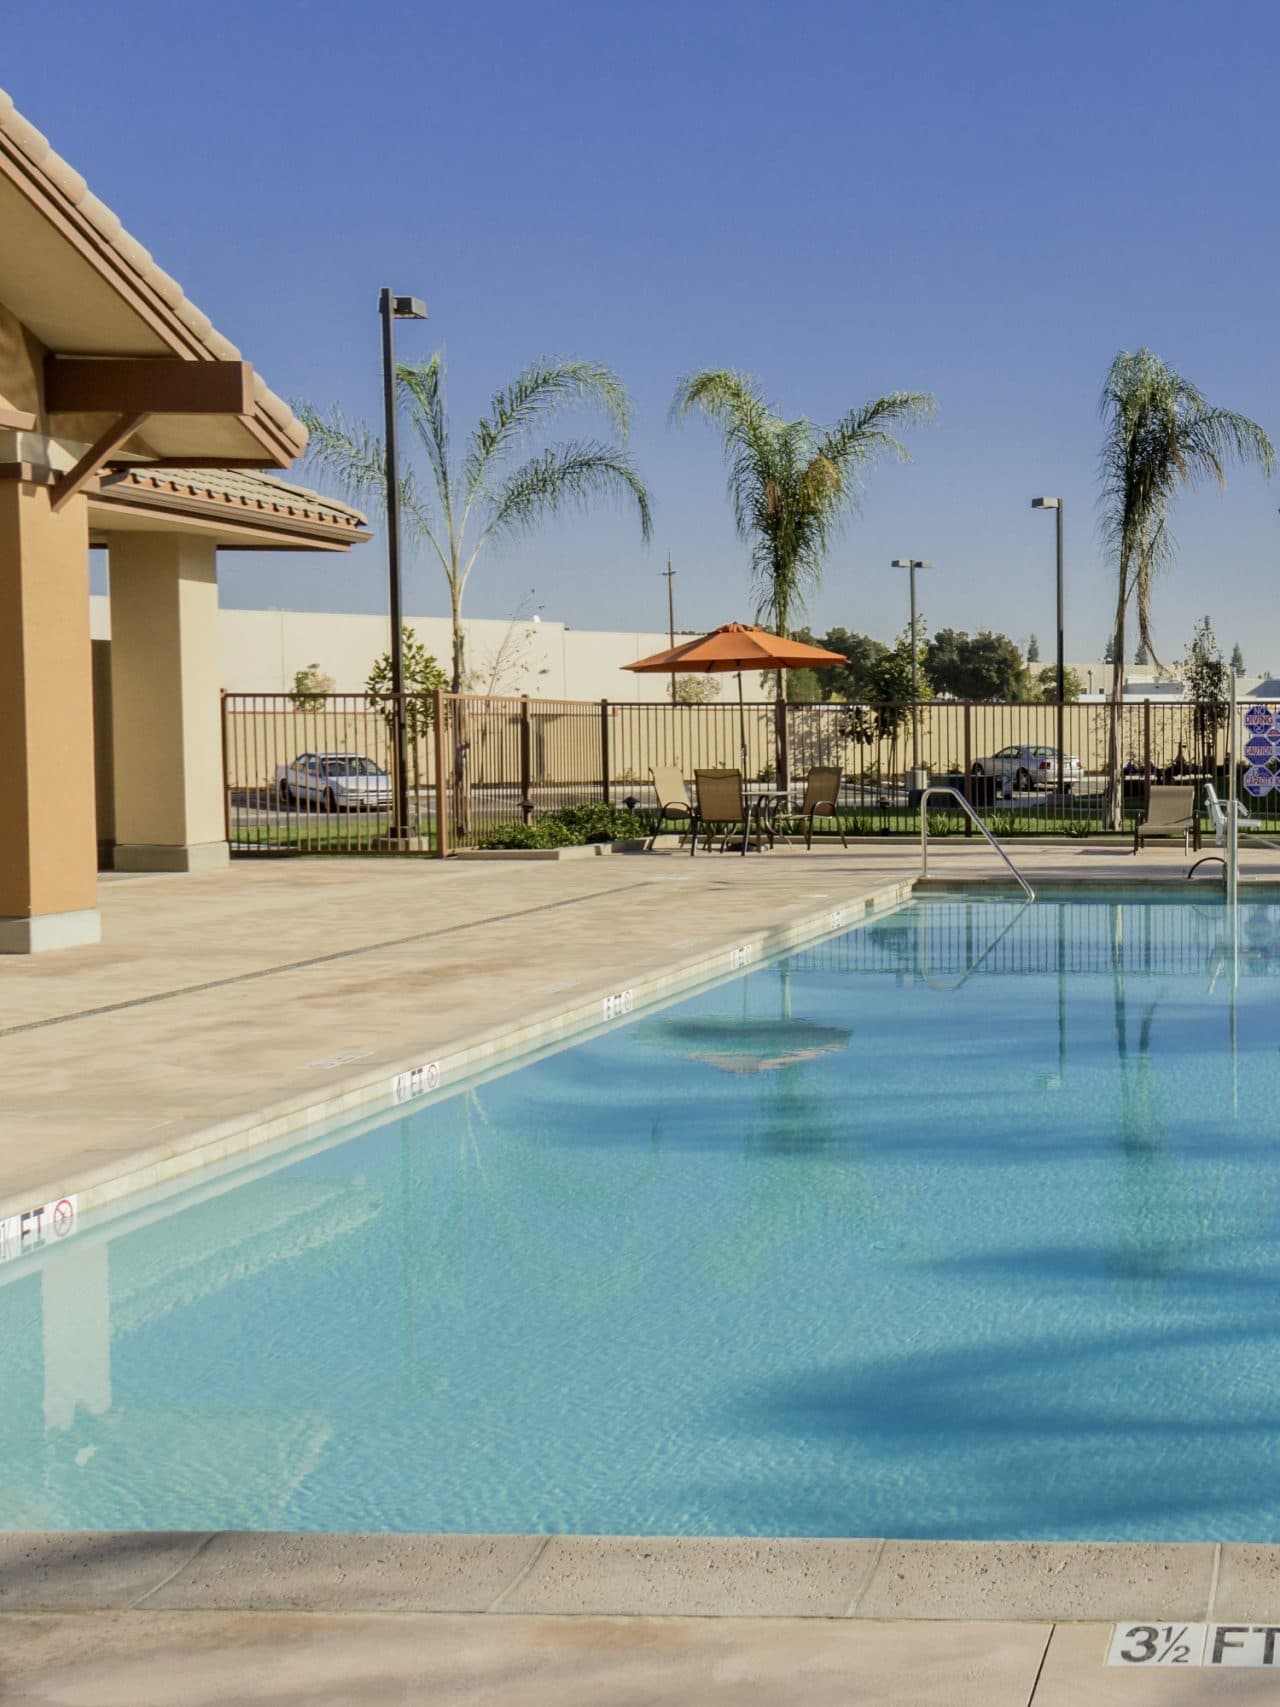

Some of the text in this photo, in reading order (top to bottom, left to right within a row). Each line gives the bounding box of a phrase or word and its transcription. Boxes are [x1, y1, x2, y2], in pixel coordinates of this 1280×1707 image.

[1254, 707, 1265, 715] NO
[1246, 715, 1273, 724] DIVING
[1246, 746, 1272, 755] CAUTION
